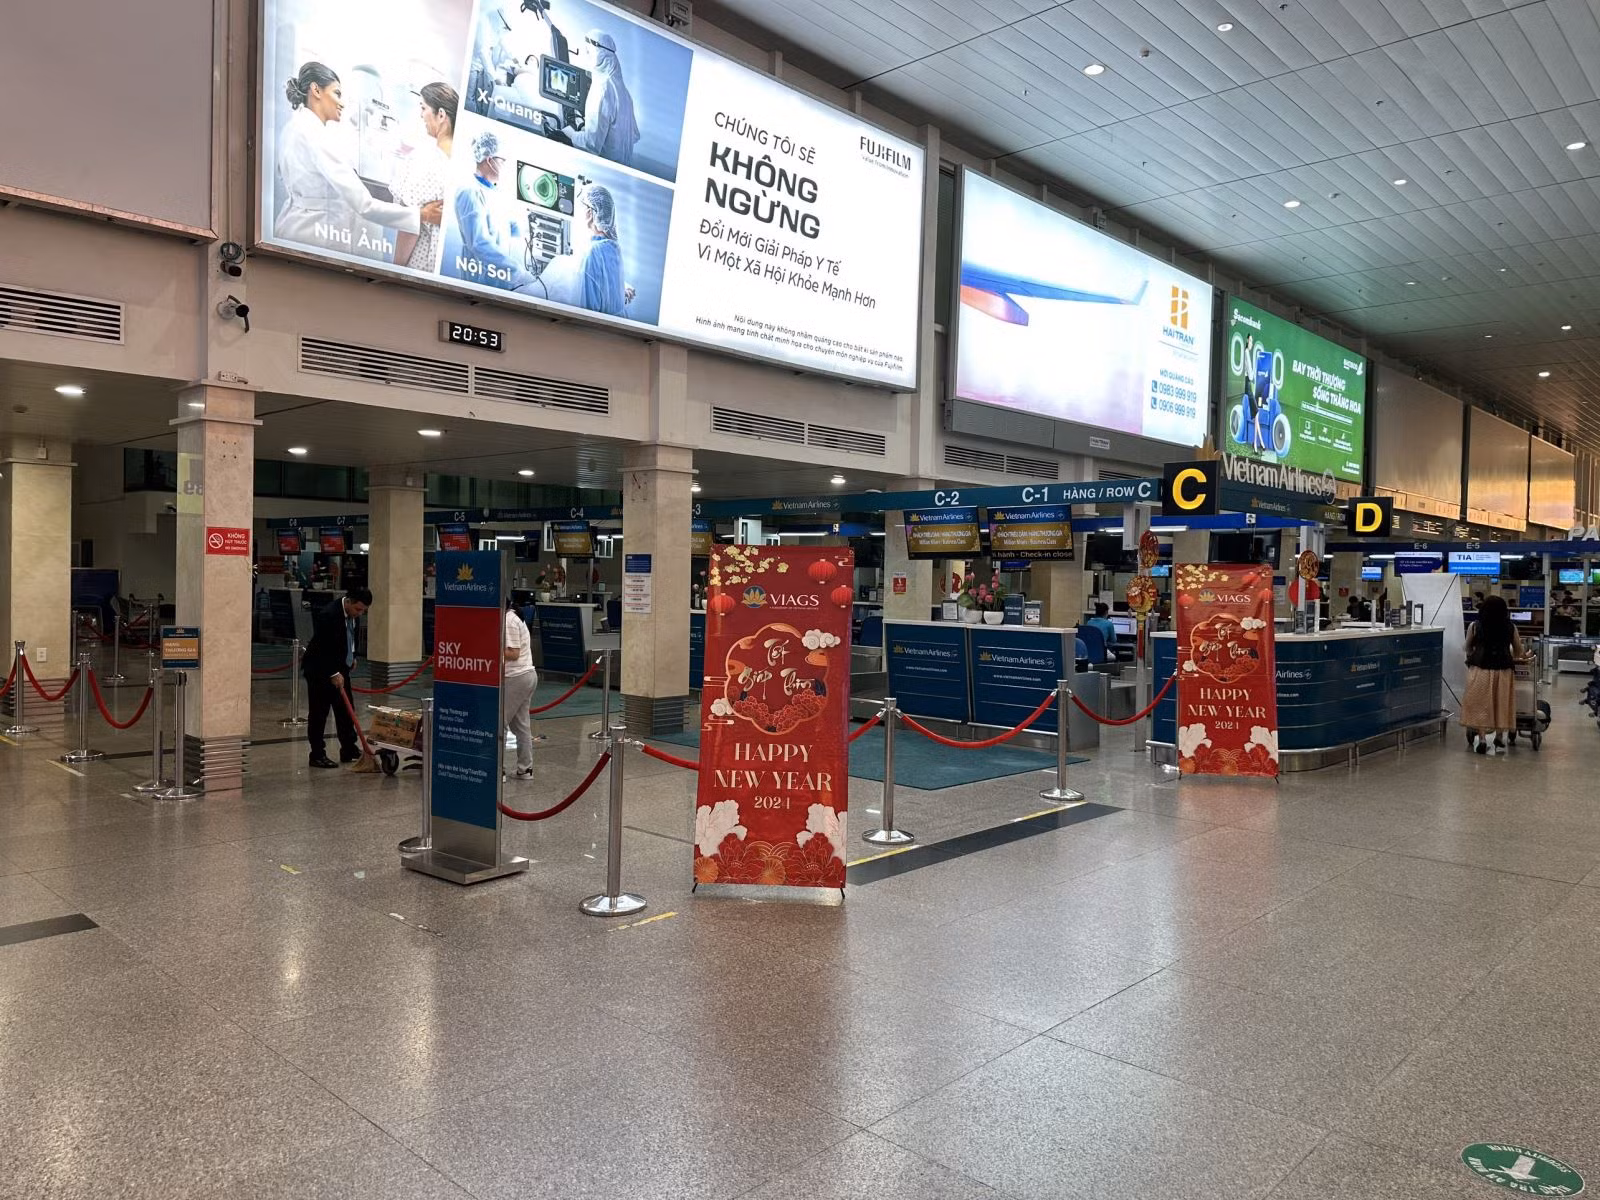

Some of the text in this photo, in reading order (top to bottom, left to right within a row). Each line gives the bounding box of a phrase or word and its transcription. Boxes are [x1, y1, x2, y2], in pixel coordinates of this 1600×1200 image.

[476, 87, 543, 124] X-Quang
[714, 111, 816, 165] CHÚNG TÔI SẼ
[709, 141, 819, 204] KHÔNG
[704, 177, 821, 240] NGỪNG
[314, 221, 394, 256] Nhũ Ảnh
[699, 218, 842, 277] Đổi Mới Giải Pháp Y Tế
[456, 255, 512, 282] Nội Soi
[697, 242, 877, 309] Vì Một Xã Hội Khỏe Mạnh Hơn
[452, 325, 498, 347] 20:53
[1292, 359, 1306, 376] BAY
[1159, 382, 1174, 397] 0983
[1175, 387, 1186, 400] 999
[1174, 403, 1185, 416] 999
[1021, 486, 1049, 503] C-1
[1063, 485, 1096, 500] HÀNG
[1106, 486, 1135, 498] ROW
[1138, 481, 1151, 498] C
[1172, 468, 1207, 510] C
[934, 491, 960, 506] C-2
[454, 511, 466, 521] C-5
[570, 507, 584, 519] C-4
[1355, 503, 1383, 533] D
[770, 594, 819, 606] VIAGS
[1216, 594, 1251, 604] VIAGS
[438, 641, 461, 656] SKY
[438, 656, 493, 673] PRIORITY
[1200, 688, 1252, 701] HAPPY
[1188, 704, 1266, 719] NEW YEAR
[734, 742, 813, 763] HAPPY
[713, 769, 833, 792] NEW YEAR
[1510, 1181, 1537, 1194] TRA
